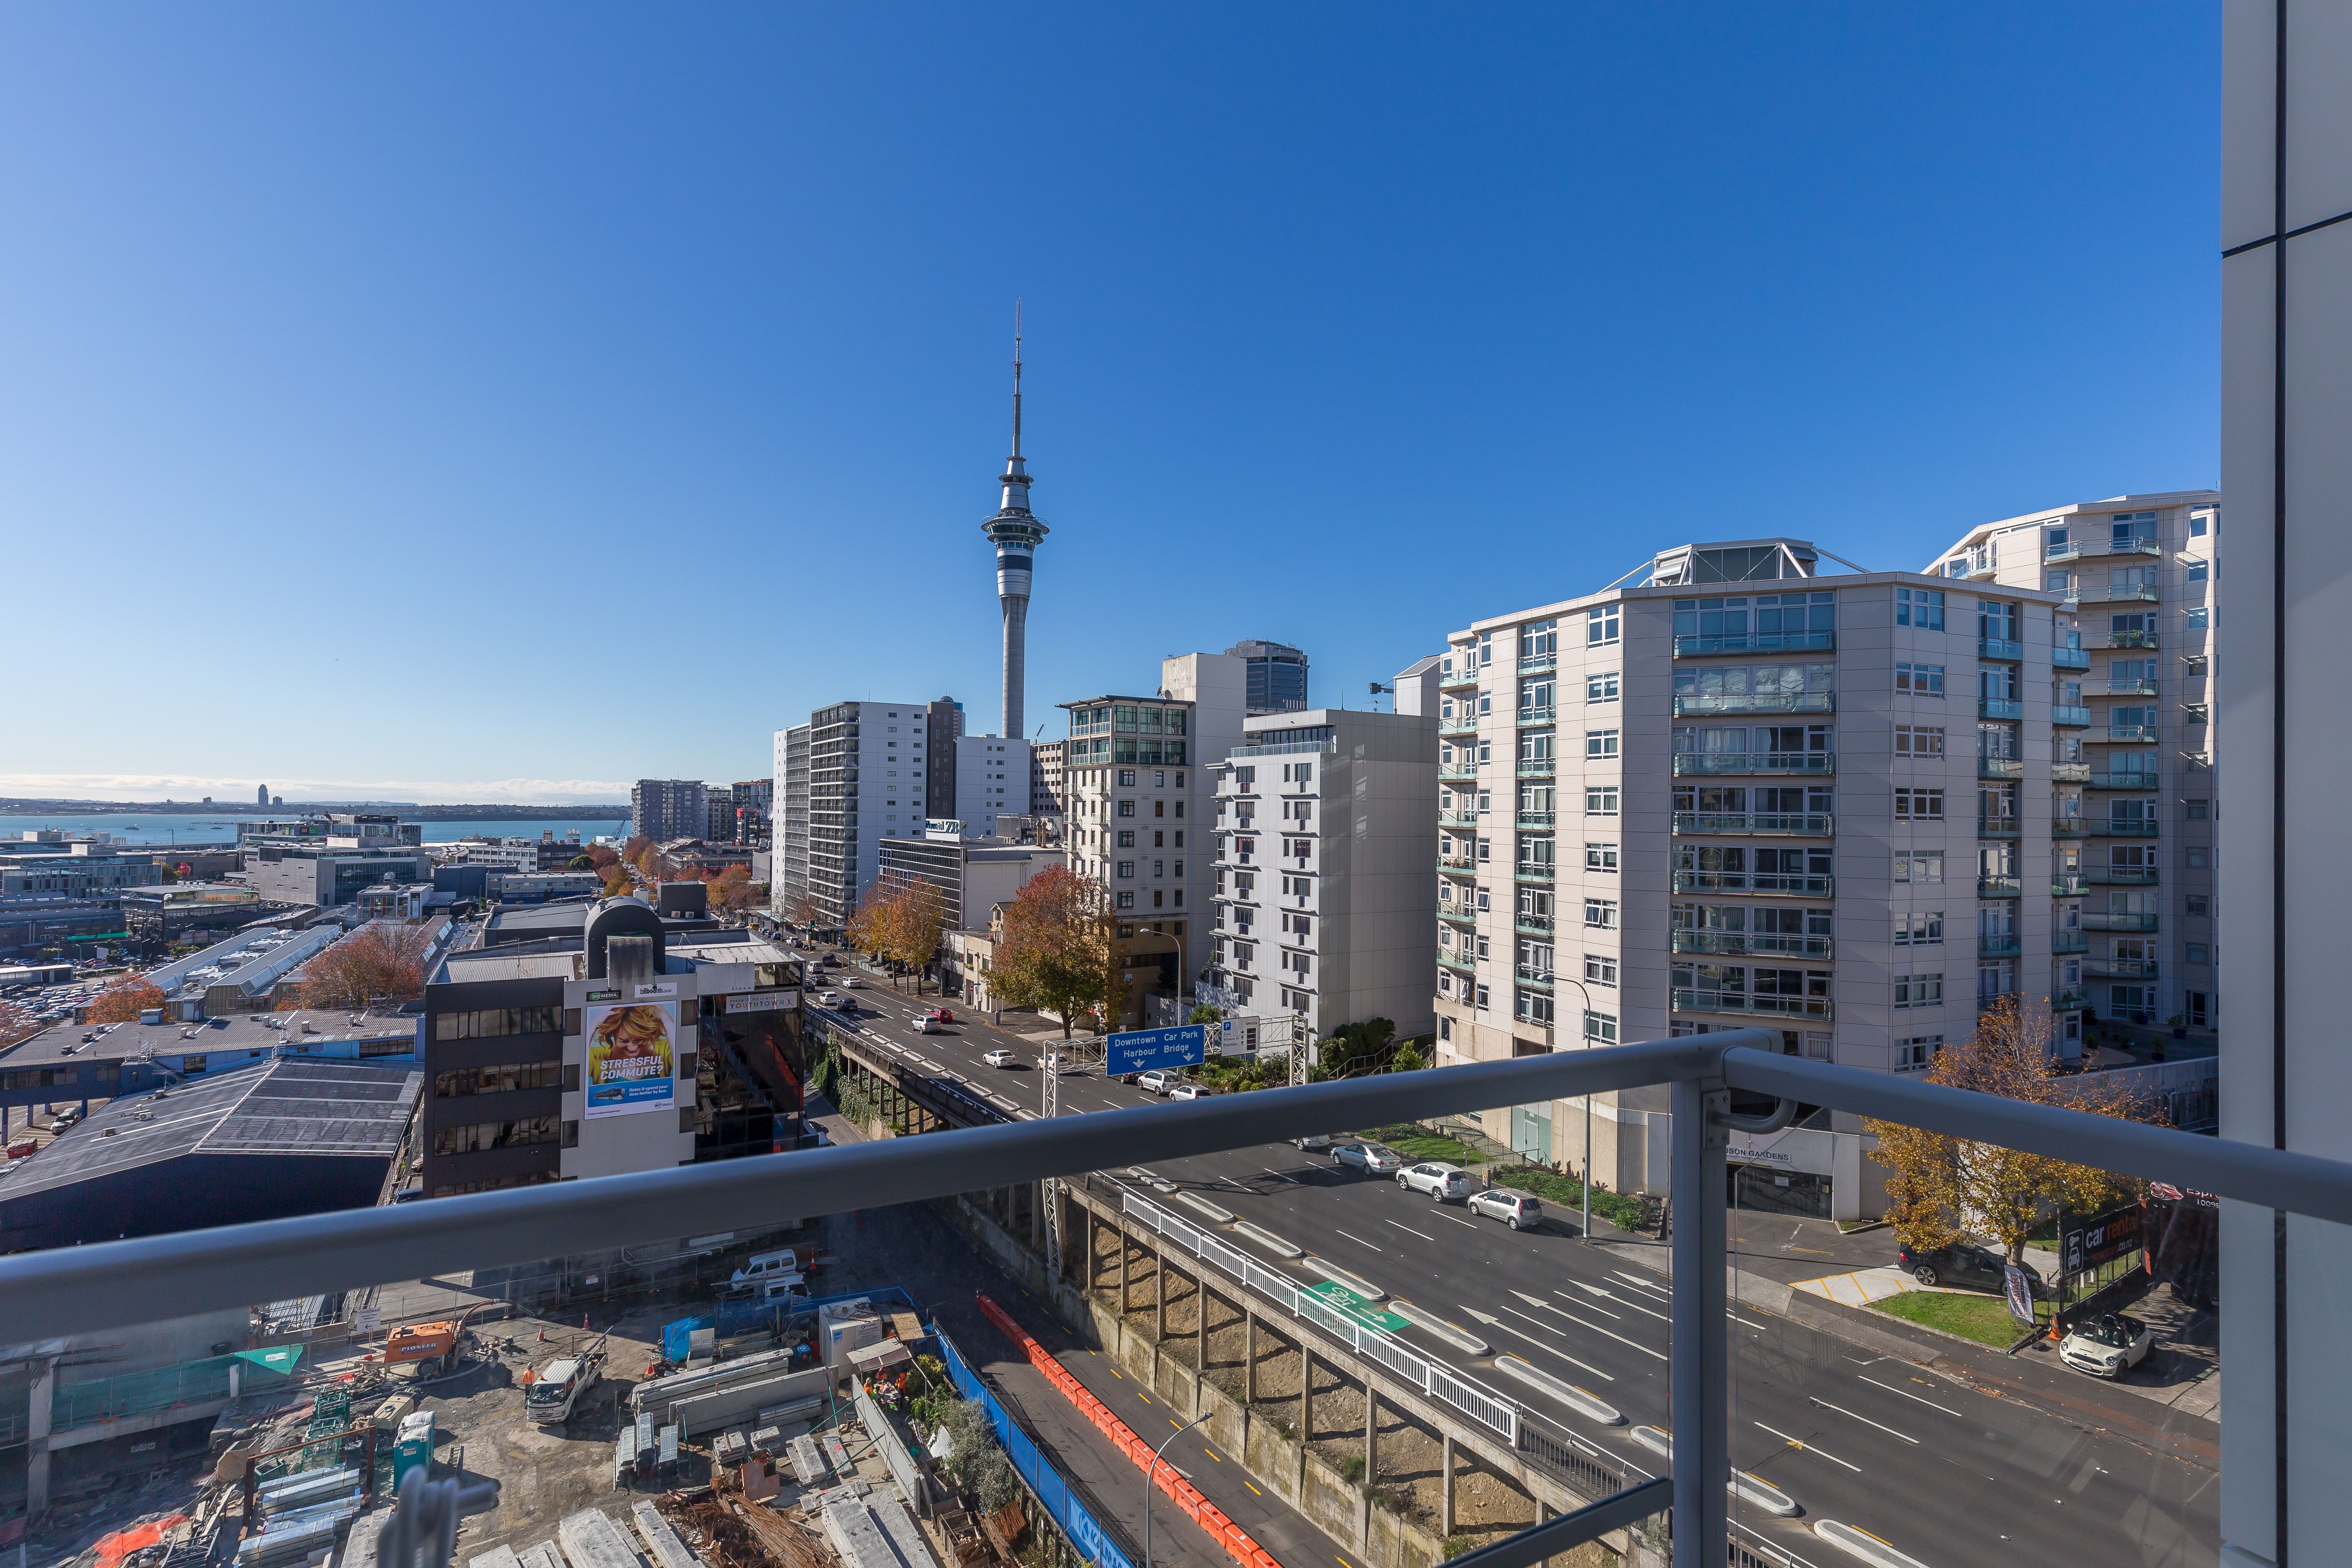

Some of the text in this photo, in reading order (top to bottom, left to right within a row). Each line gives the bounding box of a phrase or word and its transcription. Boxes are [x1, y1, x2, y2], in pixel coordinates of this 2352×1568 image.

[730, 1000, 784, 1009] YOUTHTOWN
[1115, 1036, 1156, 1047] Downtown
[1182, 1030, 1198, 1039] Park
[1124, 1044, 1189, 1058] Harbour Bridge
[600, 1055, 664, 1070] STRESSFUL
[600, 1065, 664, 1080] COMMUTE?
[1749, 1150, 1788, 1161] GARDENS
[2197, 1199, 2220, 1209] 100%
[2086, 1209, 2139, 1249] car rental
[401, 1343, 436, 1351] PIONEER
